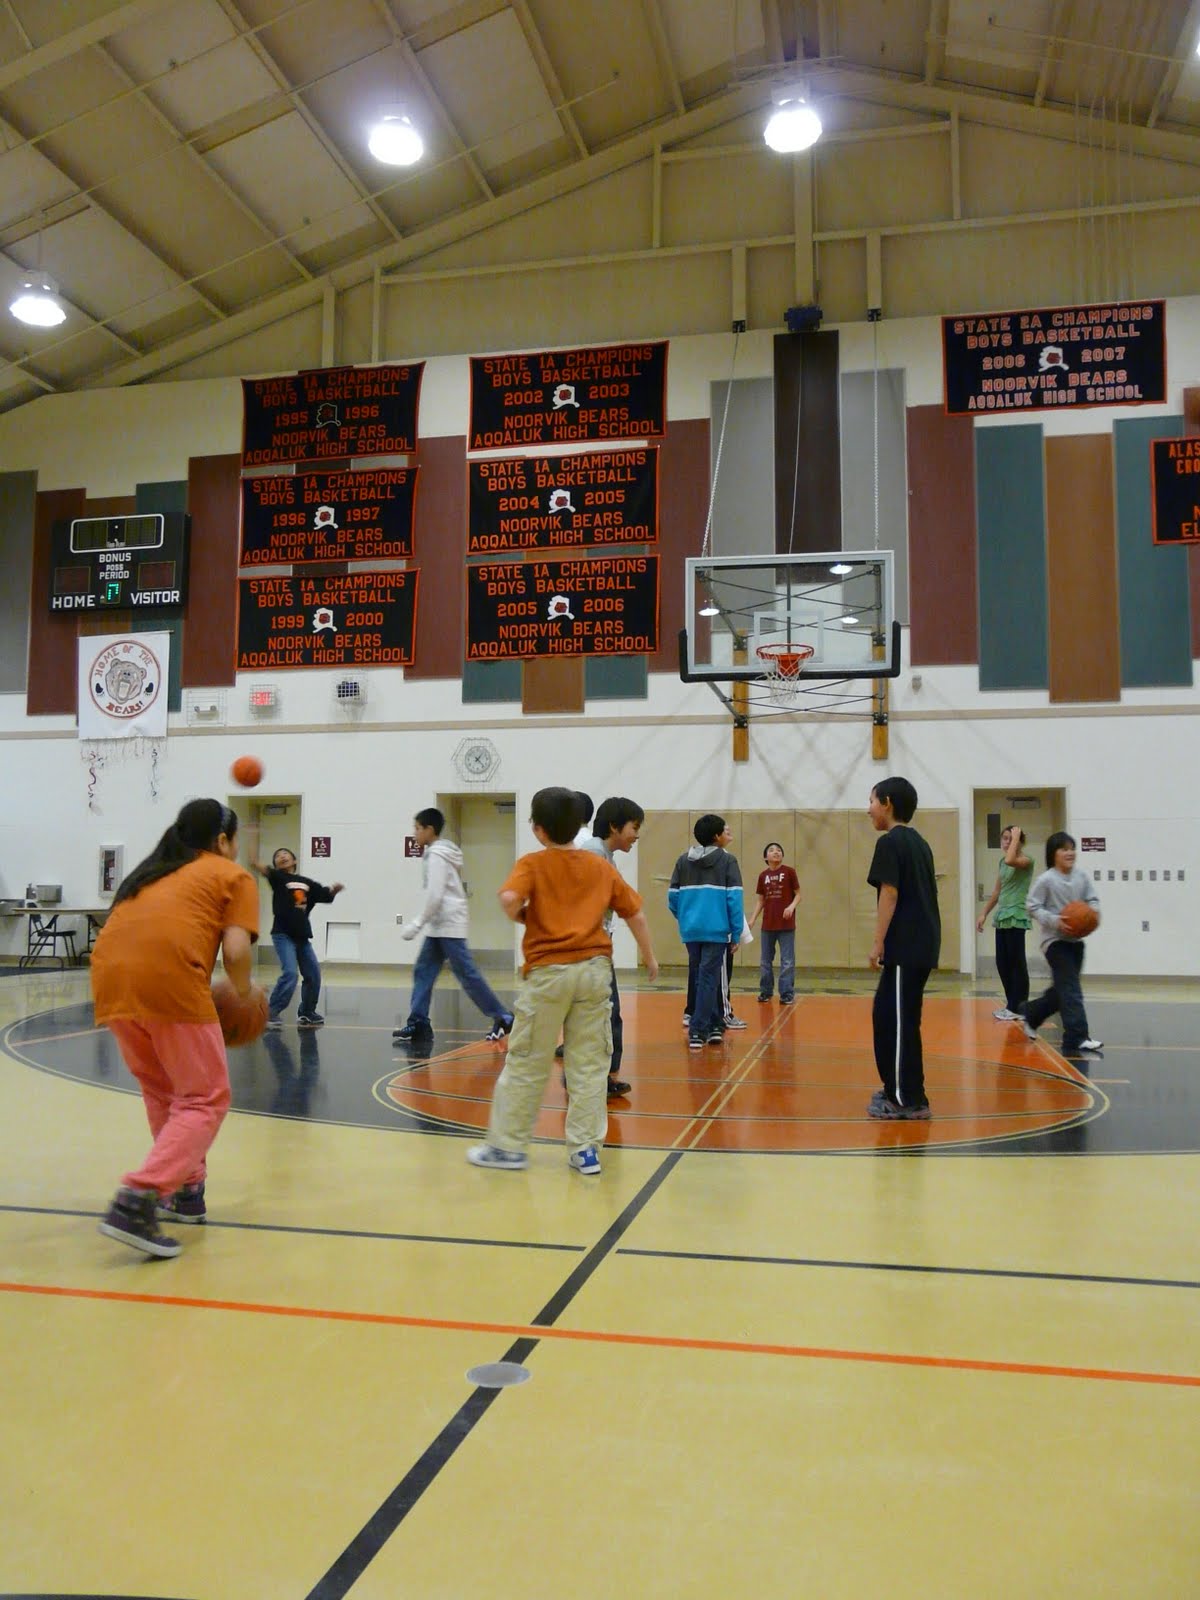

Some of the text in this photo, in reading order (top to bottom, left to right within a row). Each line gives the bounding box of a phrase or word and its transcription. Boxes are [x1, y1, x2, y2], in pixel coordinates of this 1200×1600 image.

[954, 307, 1153, 334] STATE 2A CHAMPIONS
[967, 324, 1140, 349] BOYS BASKETBALL
[484, 347, 652, 373] STATE 1A CHAMPIONS
[982, 347, 1126, 370] 2006 2007
[255, 368, 409, 394] STATE 1A CHAMPIONS
[493, 363, 642, 387] BOYS BASKETBALL
[982, 369, 1127, 392] NOORVIK BEARS
[263, 382, 400, 407] BOYS BASKETBALL
[504, 384, 630, 406] 2002 2003
[1043, 388, 1076, 405] HIGH
[1086, 384, 1143, 401] SCHOOL
[275, 406, 380, 427] 1995 1996
[504, 408, 629, 429] NOORVIK BEARS
[272, 425, 386, 446] NOORVIK BEARS
[474, 420, 660, 447] AQQALUK HIGH SCHOOL
[316, 442, 347, 456] HIGH
[358, 438, 412, 452] SCHOOL
[479, 451, 646, 477] STATE 1A CHAMPIONS
[253, 472, 407, 493] STATE 1A CHAMPIONS
[488, 468, 637, 491] BOYS BASKETBALL
[260, 487, 395, 505] BOYS BASKETBALL
[499, 490, 625, 511] 2004 2005
[272, 507, 380, 527] 1996 1997
[500, 512, 623, 533] NOORVIK BEARS
[270, 528, 383, 547] NOORVIK BEARS
[471, 525, 655, 550] AQQALUK HIGH SCHOOL
[99, 552, 132, 563] BONUS
[243, 541, 409, 563] AQQALUK HIGH SCHOOL
[99, 570, 130, 580] PERIOD
[479, 559, 647, 581] STATE 1A CHAMPIONS
[250, 574, 405, 594] STATE 1A CHAMPIONS
[487, 576, 636, 596] BOYS BASKETBALL
[52, 595, 96, 608] HOME
[131, 591, 180, 604] VISITOR
[258, 589, 396, 608] BOYS BASKETBALL
[497, 598, 624, 617] 2005 2006
[271, 612, 383, 629] 1999 2000
[499, 620, 624, 639] NOORVIK BEARS
[268, 634, 381, 650] NOORVIK BEARS
[471, 636, 654, 657] AQQALUK HIGH SCHOOL
[94, 647, 119, 677] HOME
[139, 650, 153, 667] THE
[241, 648, 409, 667] AQQALUK HIGH SCHOOL
[765, 875, 770, 884] A
[779, 873, 784, 882] F
